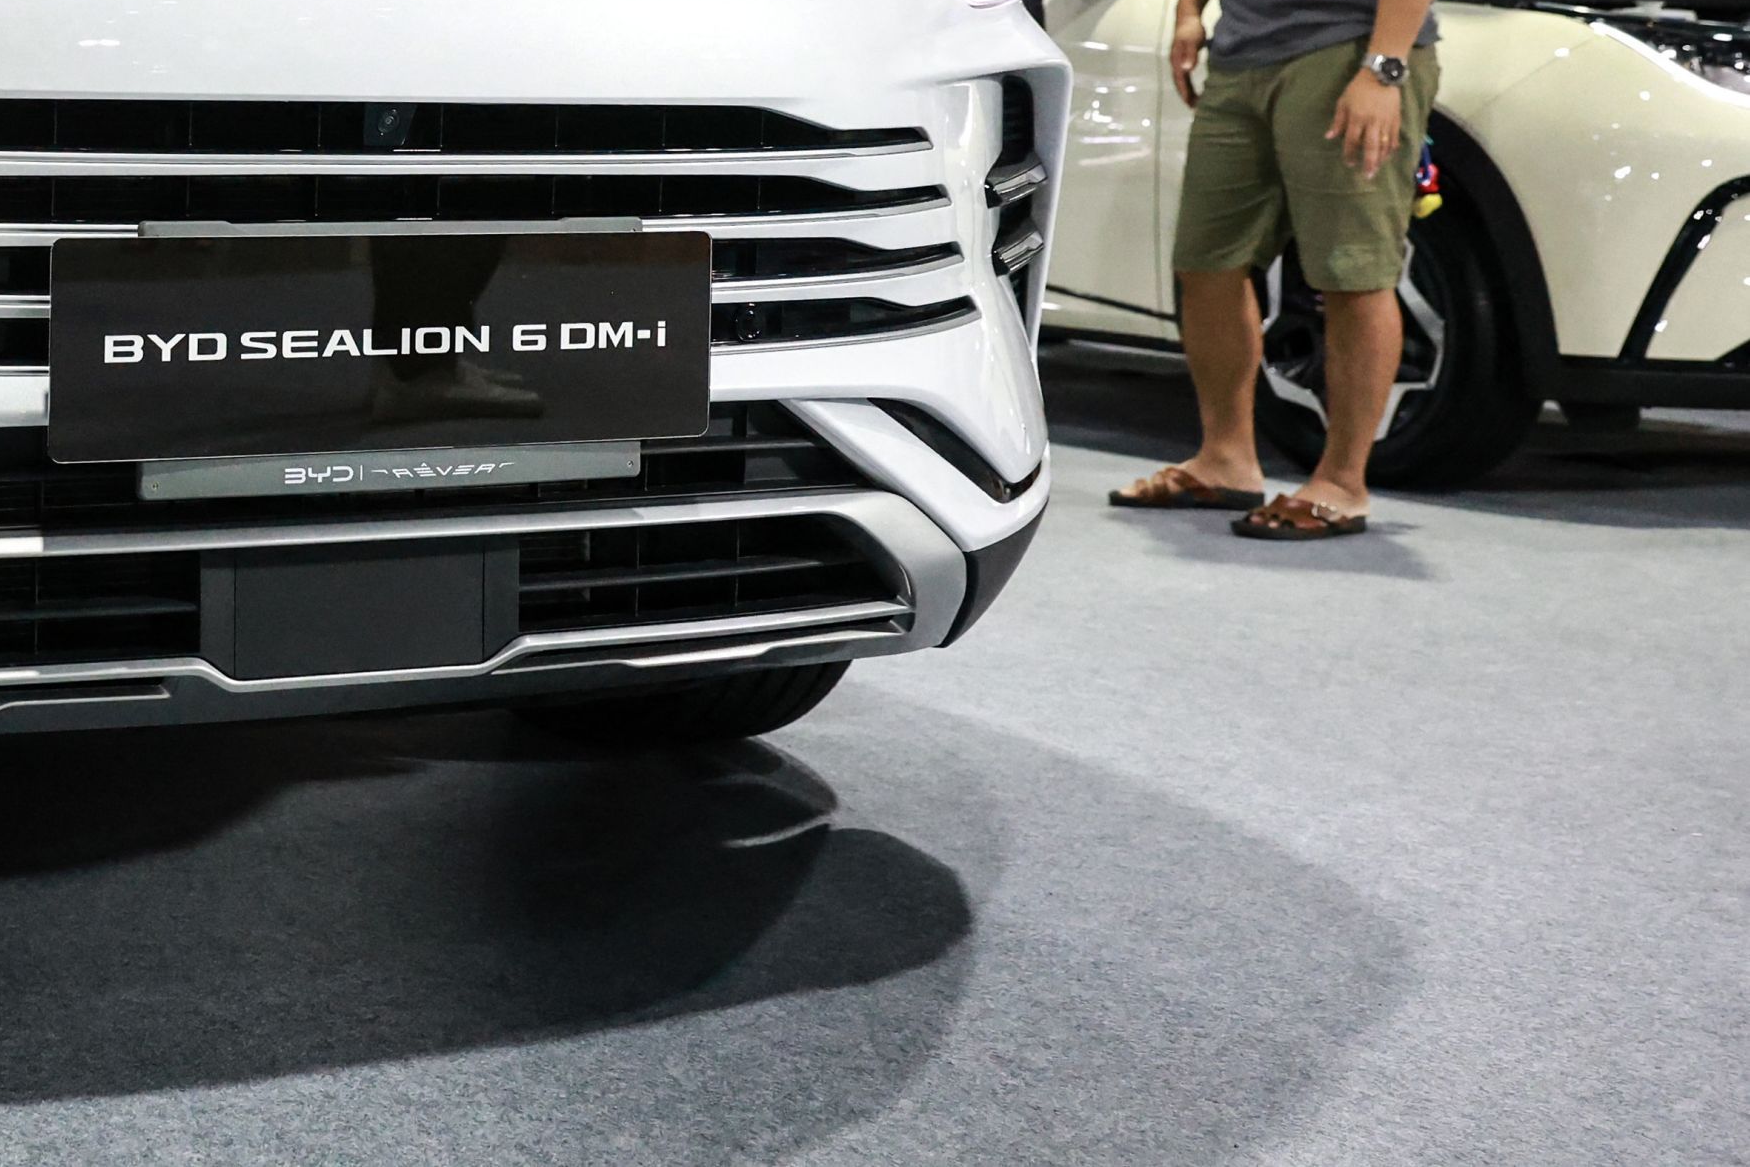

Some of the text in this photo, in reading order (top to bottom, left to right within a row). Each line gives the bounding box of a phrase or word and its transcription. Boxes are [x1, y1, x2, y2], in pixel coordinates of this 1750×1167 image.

[104, 320, 666, 364] BYD SEALION 6 DM-i
[284, 465, 354, 484] BYD
